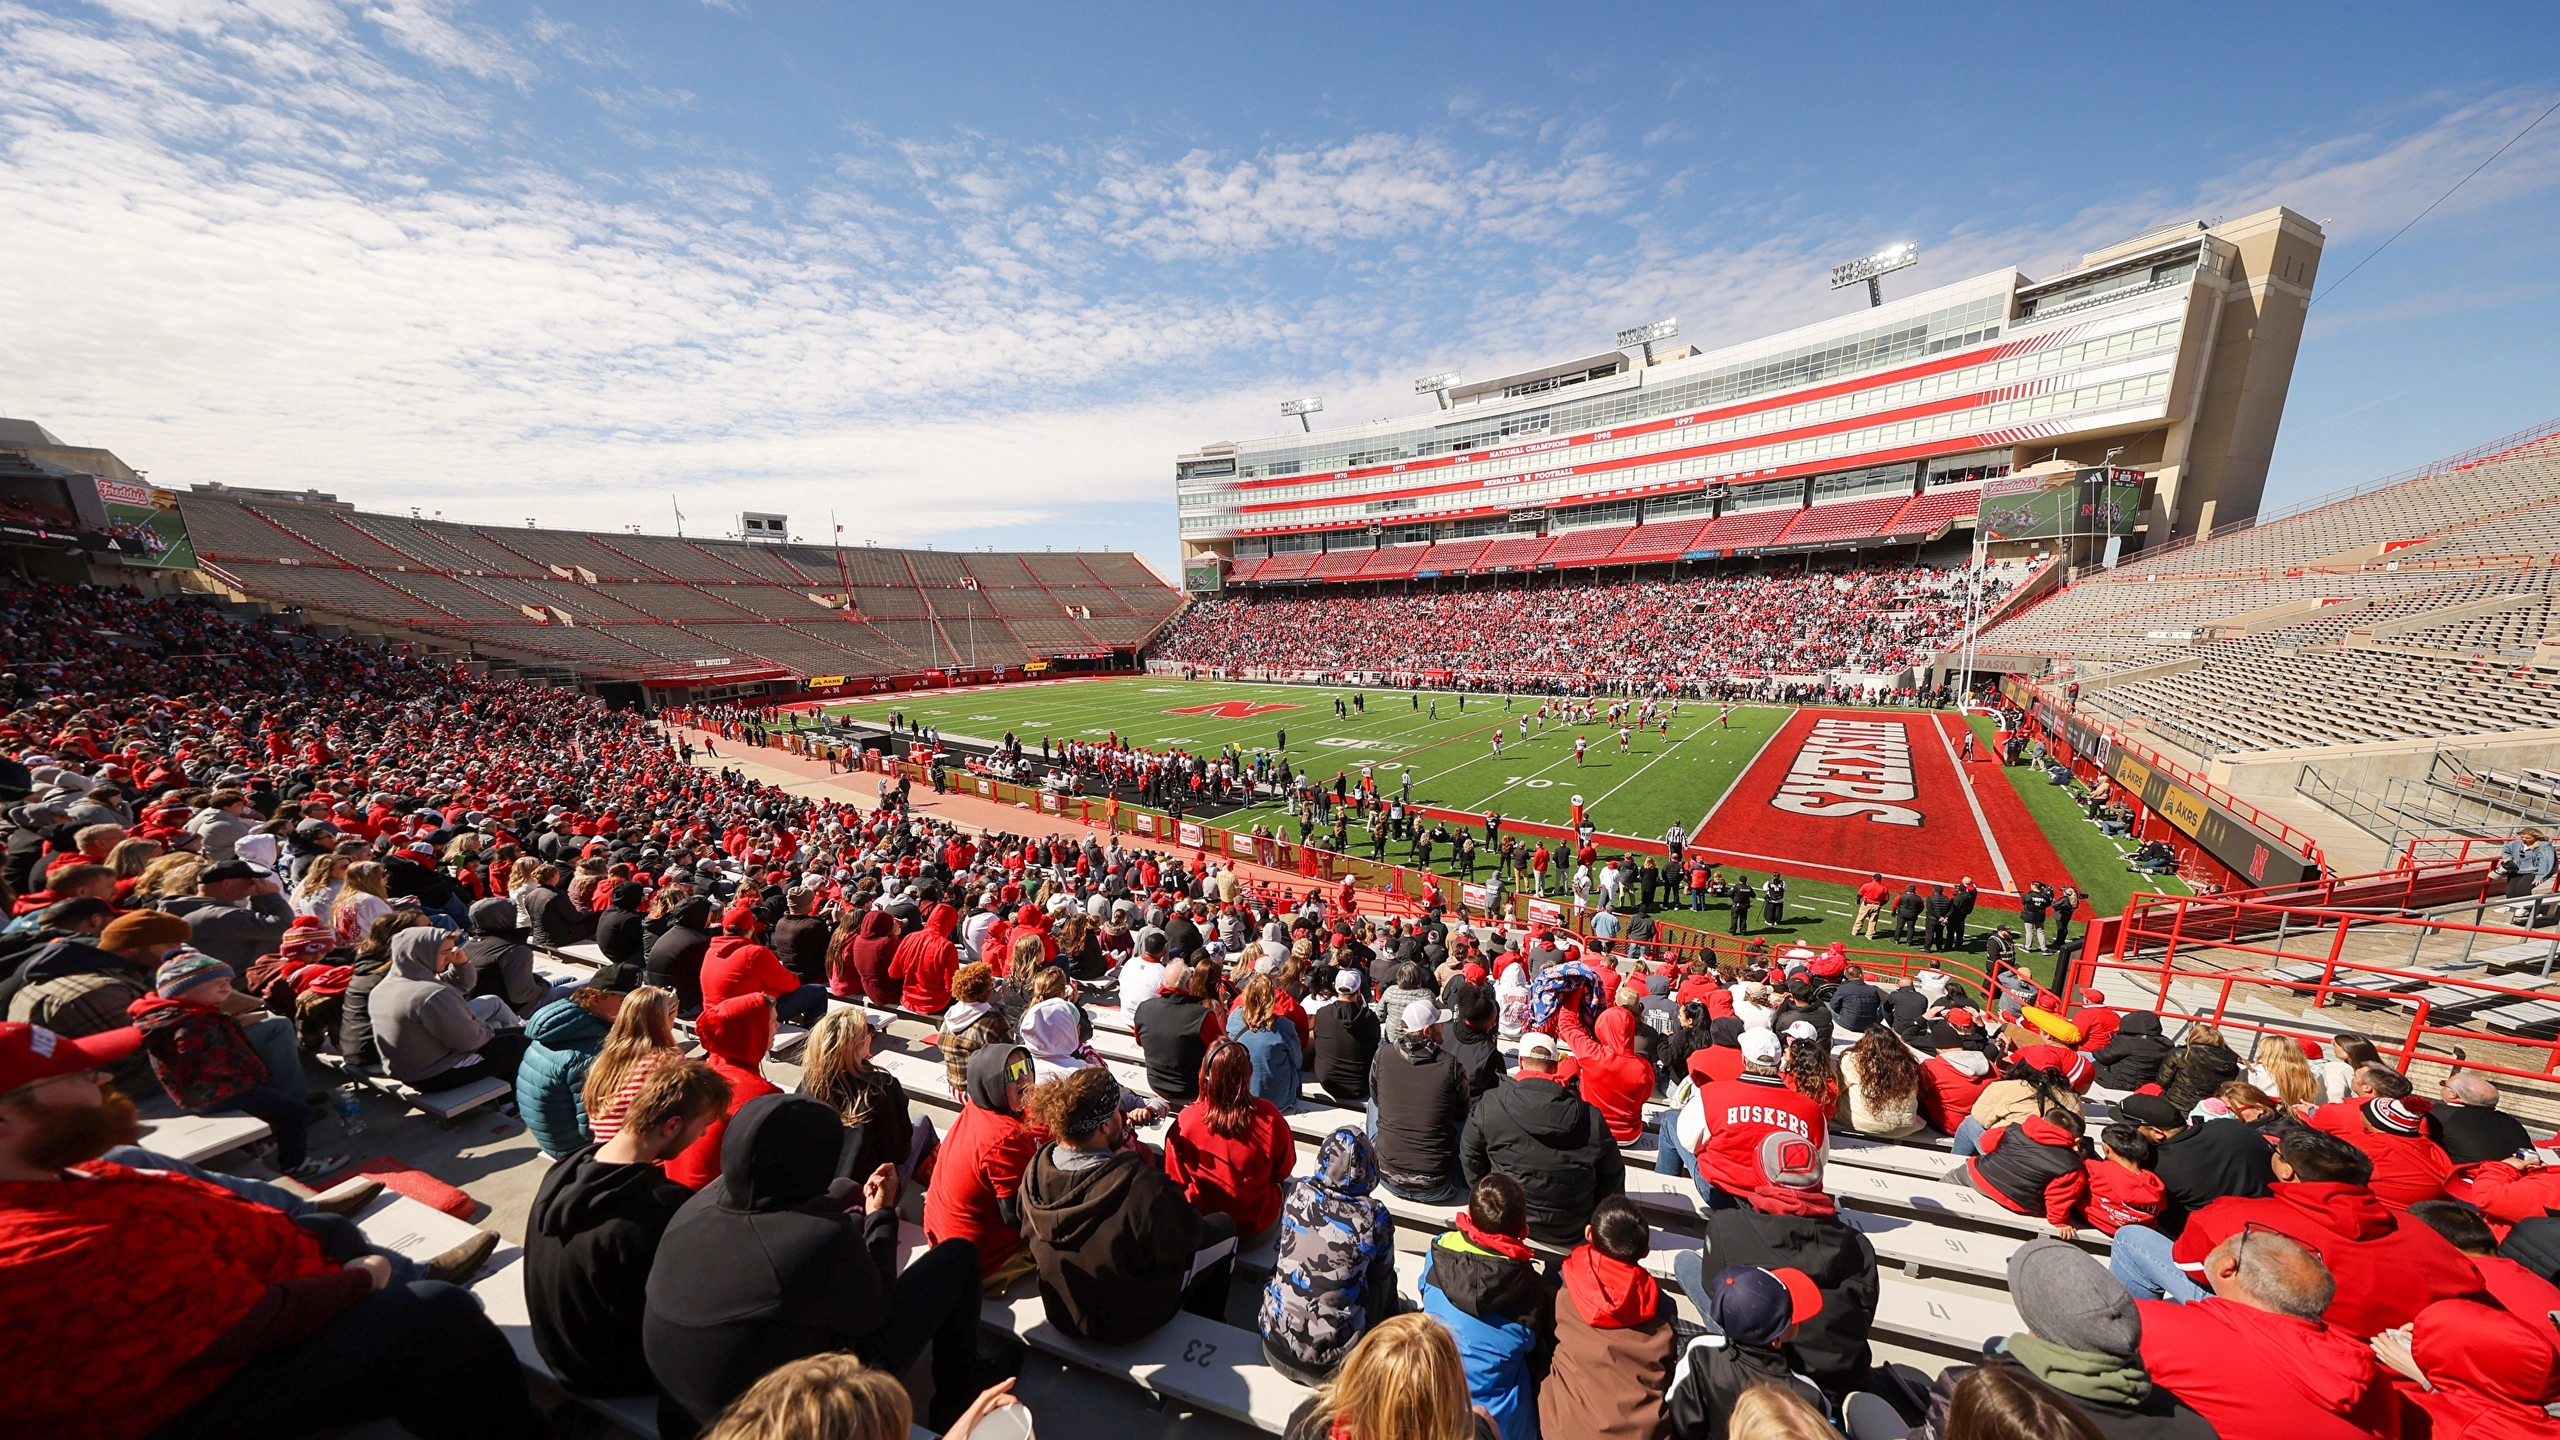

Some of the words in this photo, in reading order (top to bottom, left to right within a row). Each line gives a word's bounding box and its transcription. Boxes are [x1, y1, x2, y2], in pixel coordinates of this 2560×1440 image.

[1392, 465, 1406, 473] 1971
[1489, 446, 1524, 458] NATIONAL
[1525, 439, 1570, 452] CHAMPIONS
[1593, 432, 1611, 441] 1995
[1674, 416, 1694, 426] 1997
[1483, 475, 1520, 487] NEBRASKA
[1524, 474, 1531, 482] N
[1534, 468, 1574, 479] FOOTBALL
[98, 479, 149, 506] Freddy's
[1985, 478, 2038, 497] Freddy's
[1493, 502, 1527, 511] CONFERENCE
[1528, 498, 1561, 508] CHAMPIONS
[2081, 504, 2097, 516] N
[1957, 658, 2017, 670] NEBRASKA
[1160, 700, 1306, 718] N
[1348, 759, 1403, 770] 20
[1768, 718, 1927, 827] HUSKERS
[1503, 776, 1553, 788] 10
[2127, 769, 2143, 788] AKRS
[2175, 801, 2199, 827] AKRS
[2249, 844, 2269, 881] N
[2010, 988, 2034, 999] EVENT
[1122, 1070, 1138, 1080] 27
[1727, 1105, 1809, 1139] HUSKERS
[1641, 1139, 1655, 1149] 19
[1929, 1155, 1946, 1166] 14
[1661, 1183, 1678, 1196] 19
[1870, 1177, 1889, 1189] 16
[1955, 1192, 1976, 1204] 15
[1944, 1238, 1968, 1254] 16
[1927, 1301, 1951, 1321] 17
[1183, 1339, 1217, 1368] 23
